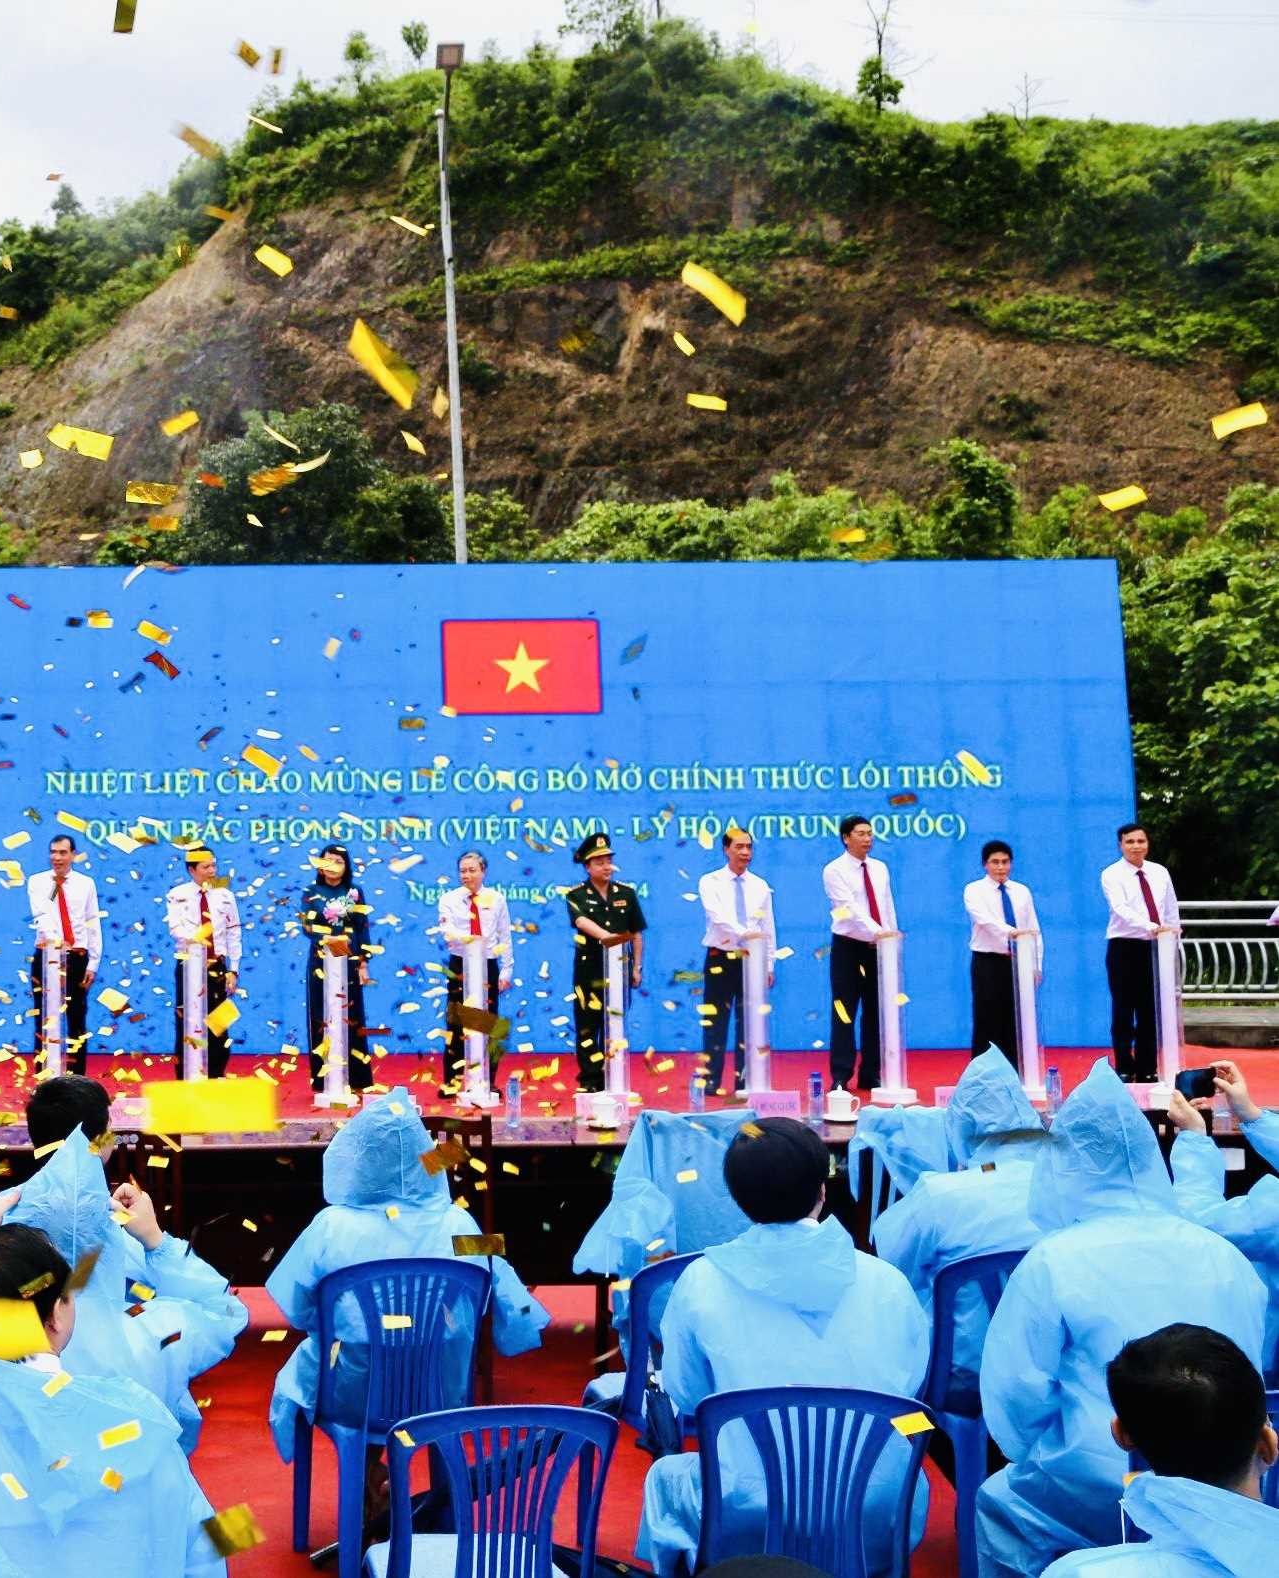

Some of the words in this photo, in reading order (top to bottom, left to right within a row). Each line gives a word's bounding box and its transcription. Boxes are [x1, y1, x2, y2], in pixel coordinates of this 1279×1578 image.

[45, 769, 136, 798] NHIỆT
[142, 769, 210, 798] LIỆT
[310, 764, 403, 794] MỪNG
[453, 762, 539, 793] CÔNG
[547, 762, 588, 792] BỐ
[595, 762, 643, 791] MỞ
[649, 760, 744, 791] CHÍNH
[751, 760, 834, 790] THỨC
[842, 760, 891, 789] LỐI
[898, 760, 1002, 789] THÔNG
[249, 818, 354, 843] PHONG
[361, 818, 433, 842] SINH
[439, 815, 520, 847] (VIỆT
[748, 814, 850, 841] (TRUN
[870, 808, 967, 842] QUỐC)
